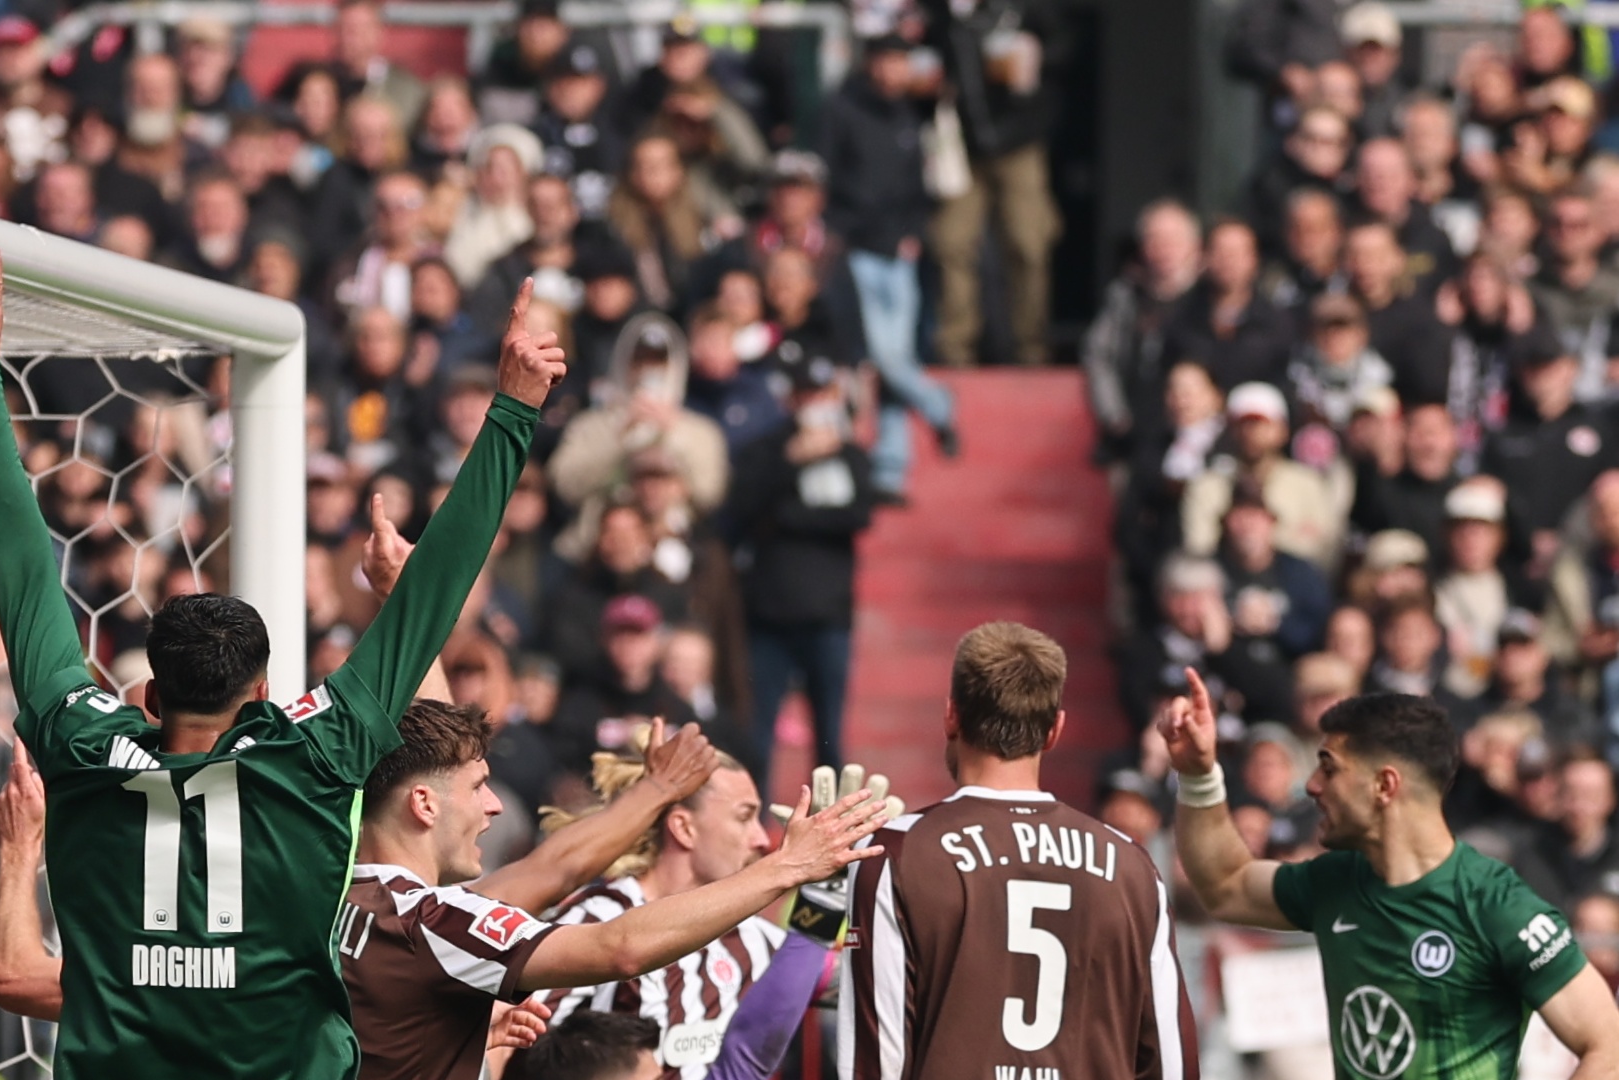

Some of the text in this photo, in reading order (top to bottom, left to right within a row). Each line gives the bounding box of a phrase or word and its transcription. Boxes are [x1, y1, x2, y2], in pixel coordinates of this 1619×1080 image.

[121, 760, 243, 933] 11
[940, 822, 1116, 882] ST. PAULI
[132, 944, 236, 989] DAGHIM
[1002, 879, 1072, 1052] 5
